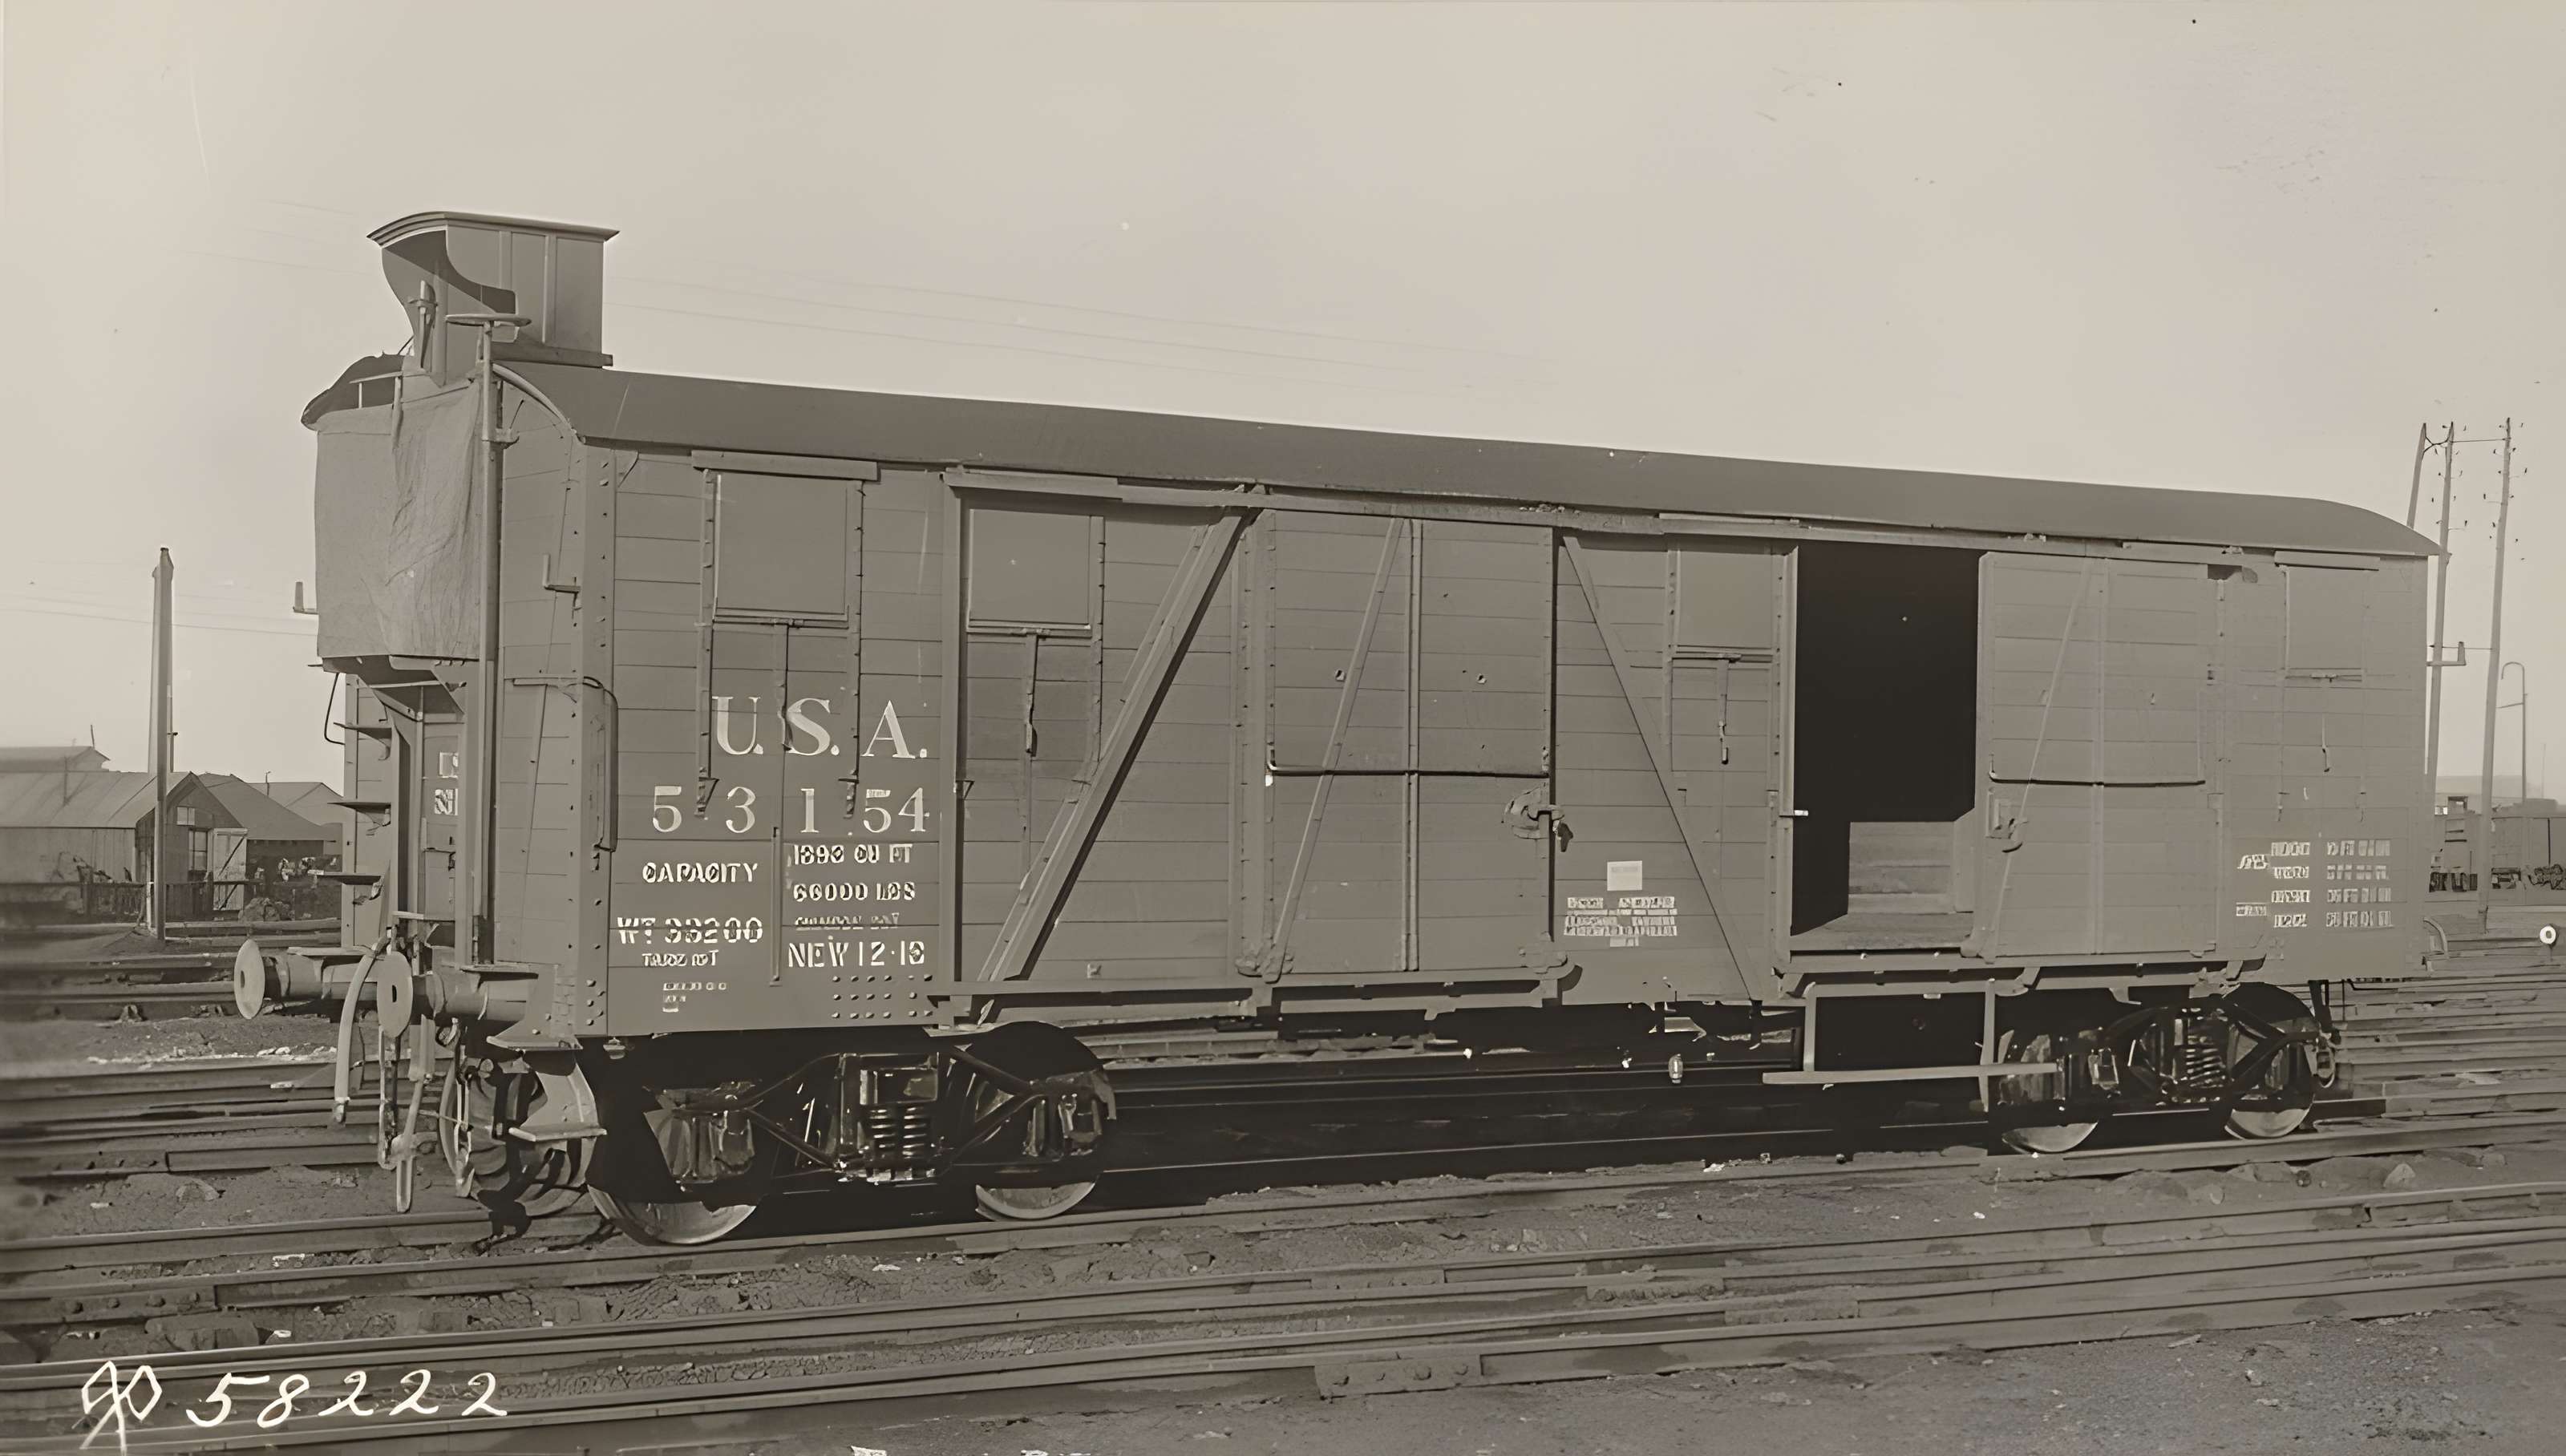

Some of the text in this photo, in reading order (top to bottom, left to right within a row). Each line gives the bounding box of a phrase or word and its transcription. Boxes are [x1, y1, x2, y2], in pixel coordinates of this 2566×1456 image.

[642, 862, 758, 884] CAPACITY
[793, 883, 868, 902] 66000
[788, 941, 848, 968] NEW
